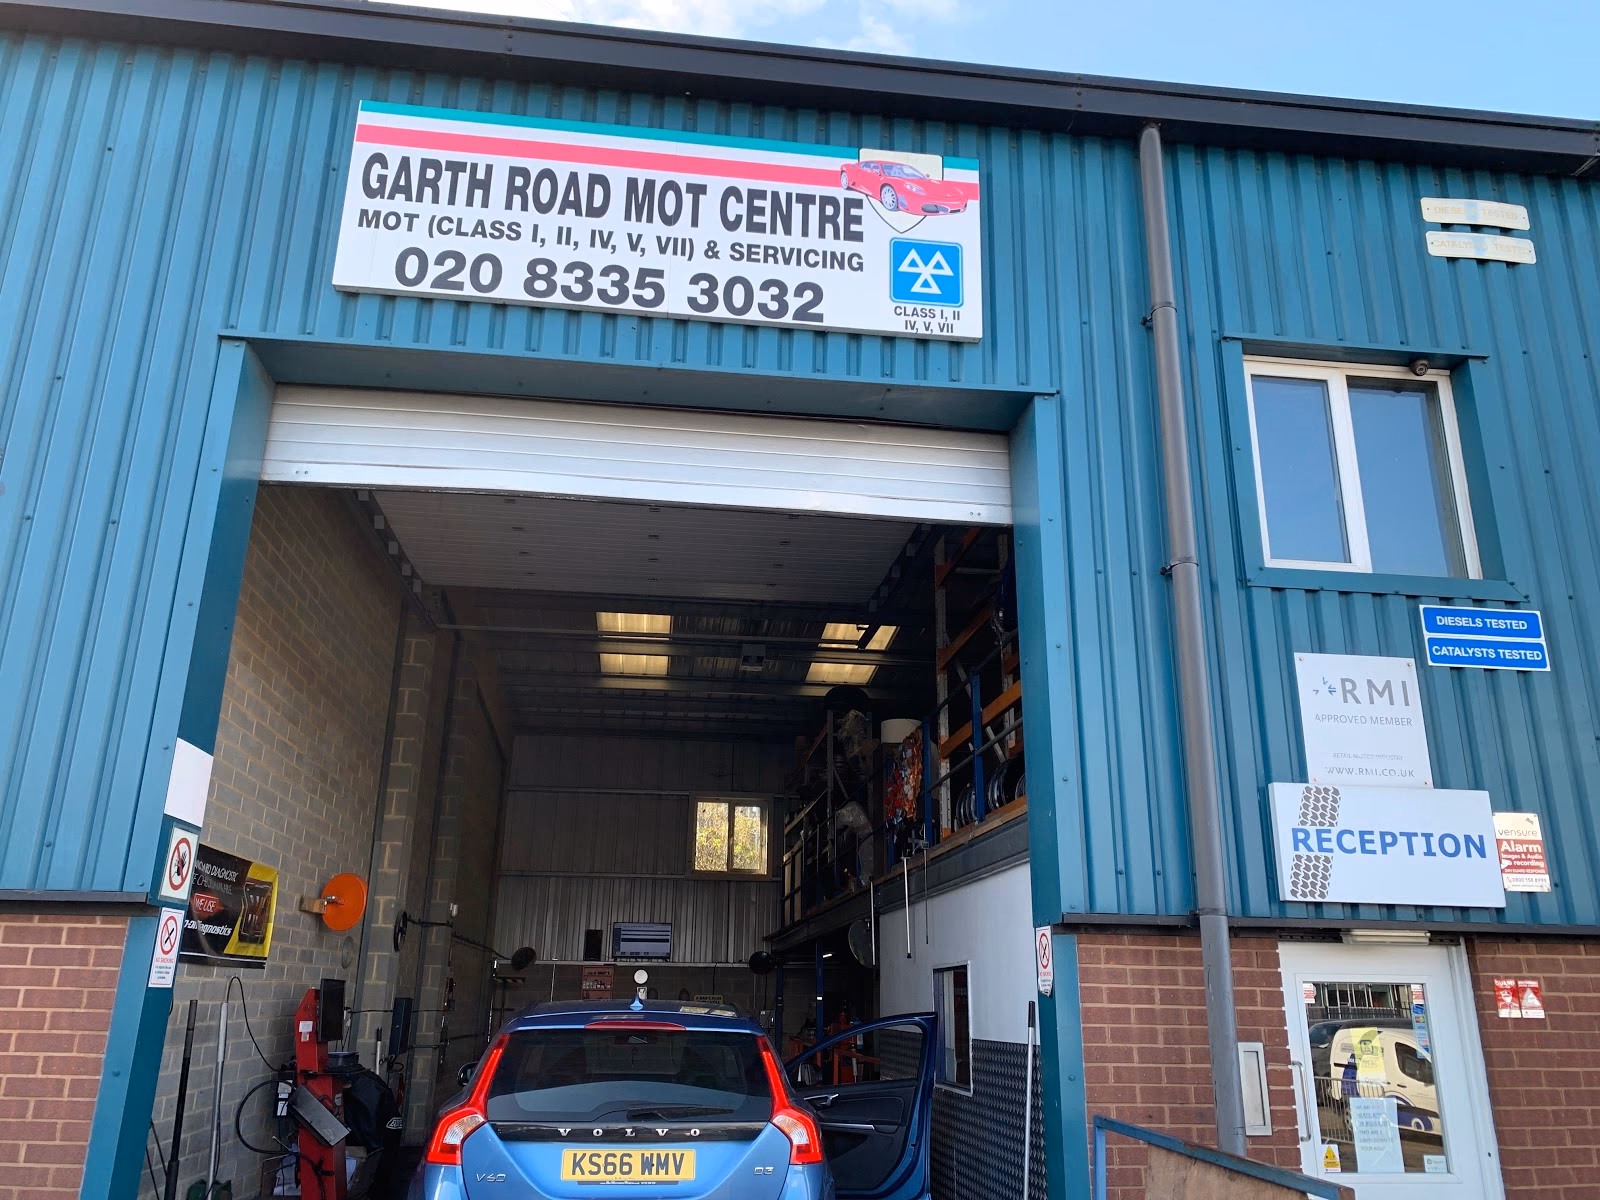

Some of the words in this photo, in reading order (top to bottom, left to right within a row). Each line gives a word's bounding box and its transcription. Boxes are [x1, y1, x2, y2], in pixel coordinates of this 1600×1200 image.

[361, 151, 494, 209] GARTH
[504, 165, 612, 219] ROAD
[624, 176, 708, 229] MOT
[719, 185, 864, 243] CENTRE
[1434, 206, 1476, 215] DIESE
[1482, 208, 1518, 219] TESTED
[357, 208, 420, 232] MOT
[428, 214, 522, 242] (CLASS
[531, 223, 546, 249] I,
[556, 225, 579, 251] II,
[589, 229, 617, 255] IV,
[626, 232, 646, 257] V,
[655, 235, 695, 262] VII)
[703, 239, 721, 260] &
[729, 242, 864, 272] SERVICING
[1433, 239, 1489, 250] CATALYSS
[1494, 243, 1529, 254] TESTED
[394, 246, 503, 294] 020
[523, 257, 665, 309] 8335
[686, 272, 824, 323] 3032
[894, 305, 936, 319] CLASS
[940, 309, 948, 322] I,
[952, 310, 961, 321] II
[904, 319, 919, 333] IV,
[923, 321, 934, 334] V,
[938, 322, 954, 333] VII
[1436, 615, 1483, 628] DIESELS
[1484, 618, 1528, 630] TESTED
[1432, 645, 1496, 658] CATALYSTS
[1498, 649, 1542, 661] TESTED
[1340, 677, 1410, 707] RMI
[1315, 713, 1367, 724] APPROVED
[1370, 716, 1413, 726] MEMBER
[1325, 766, 1415, 778] WWW.RMI.CO.UK
[1498, 829, 1538, 837] verisure
[1291, 827, 1487, 859] RECEPTION
[1501, 840, 1542, 853] Alarm
[1513, 860, 1545, 868] recording
[558, 1128, 701, 1137] VOLVO
[571, 1152, 633, 1176] KS66
[640, 1152, 685, 1176] WMV
[753, 1166, 774, 1175] D3
[475, 1173, 506, 1182] V60
